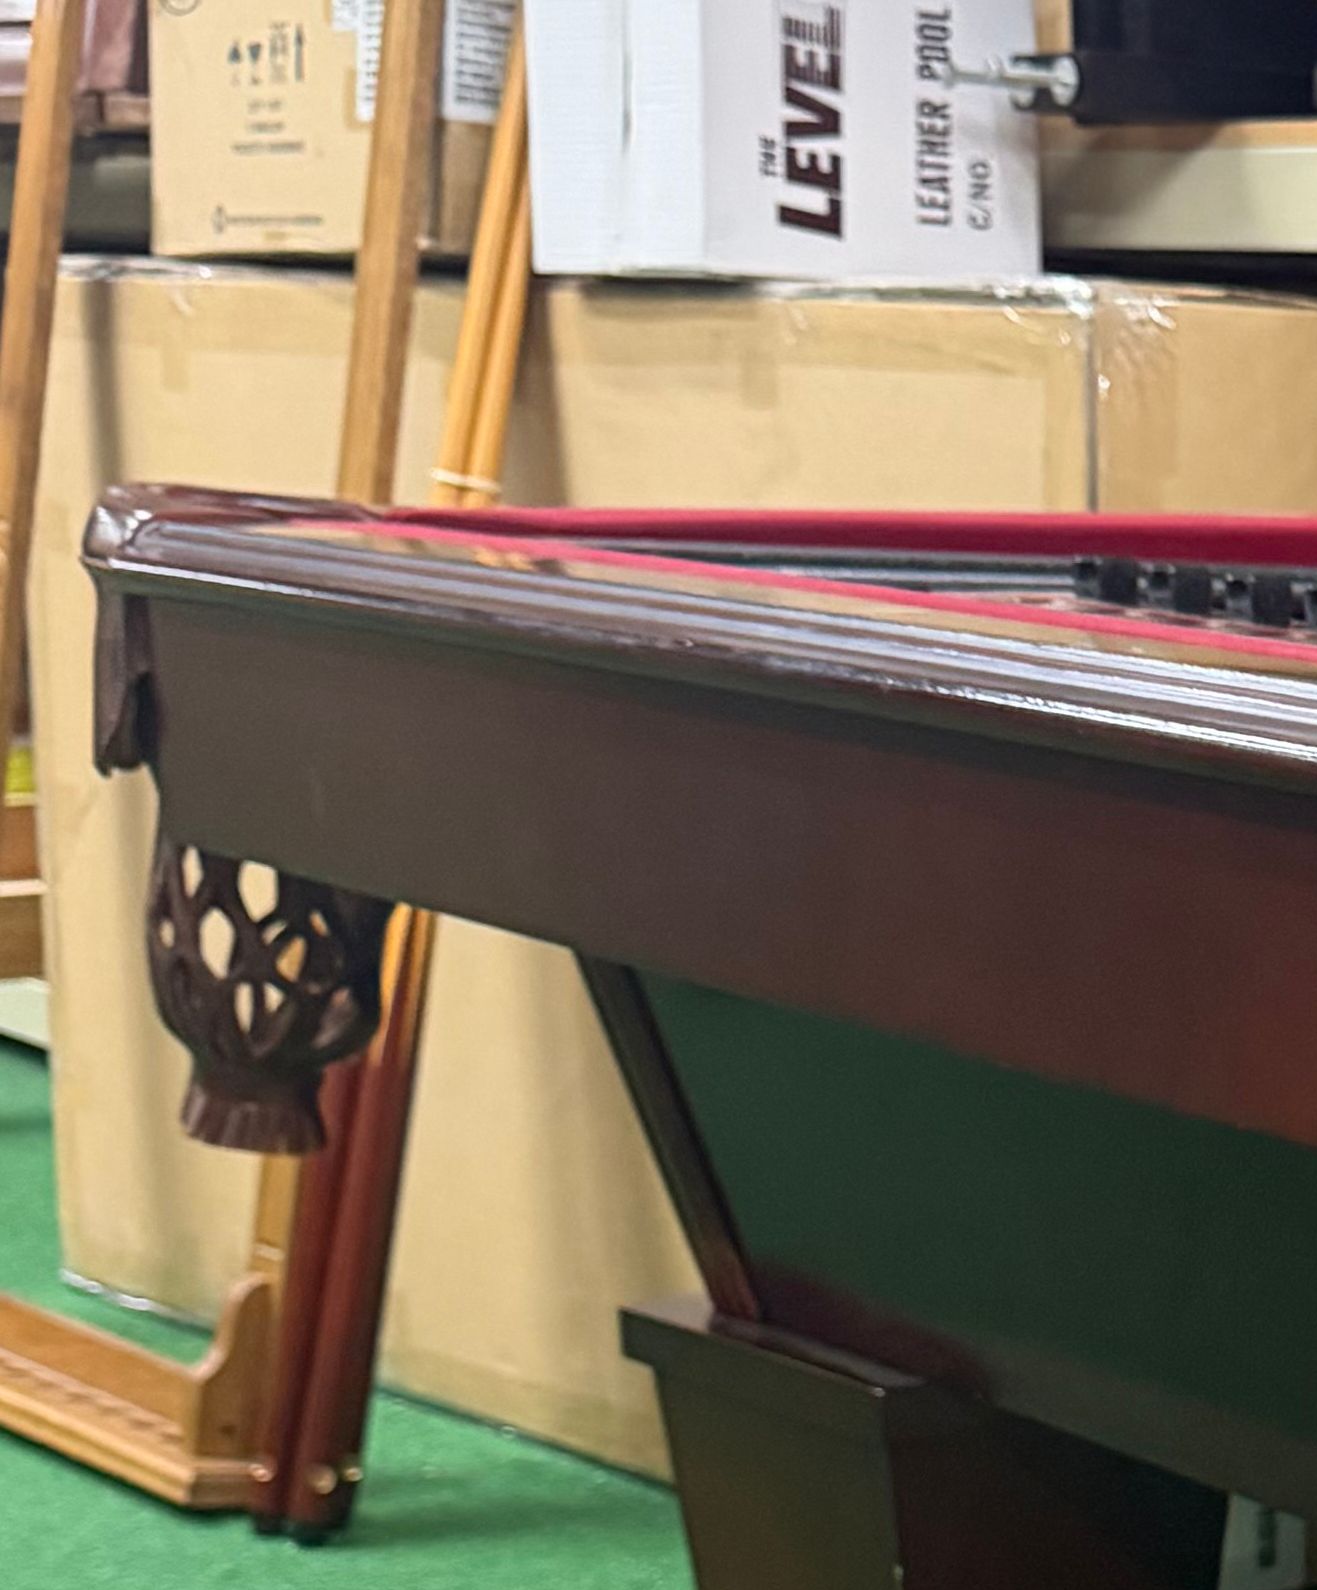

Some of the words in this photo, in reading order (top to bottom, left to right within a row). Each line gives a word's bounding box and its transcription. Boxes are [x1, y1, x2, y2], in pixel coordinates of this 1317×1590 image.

[917, 7, 951, 81] POOL
[759, 134, 778, 178] THE
[777, 5, 842, 239] LEVEL
[916, 98, 951, 228] LEATHER
[967, 159, 993, 232] C/NO
